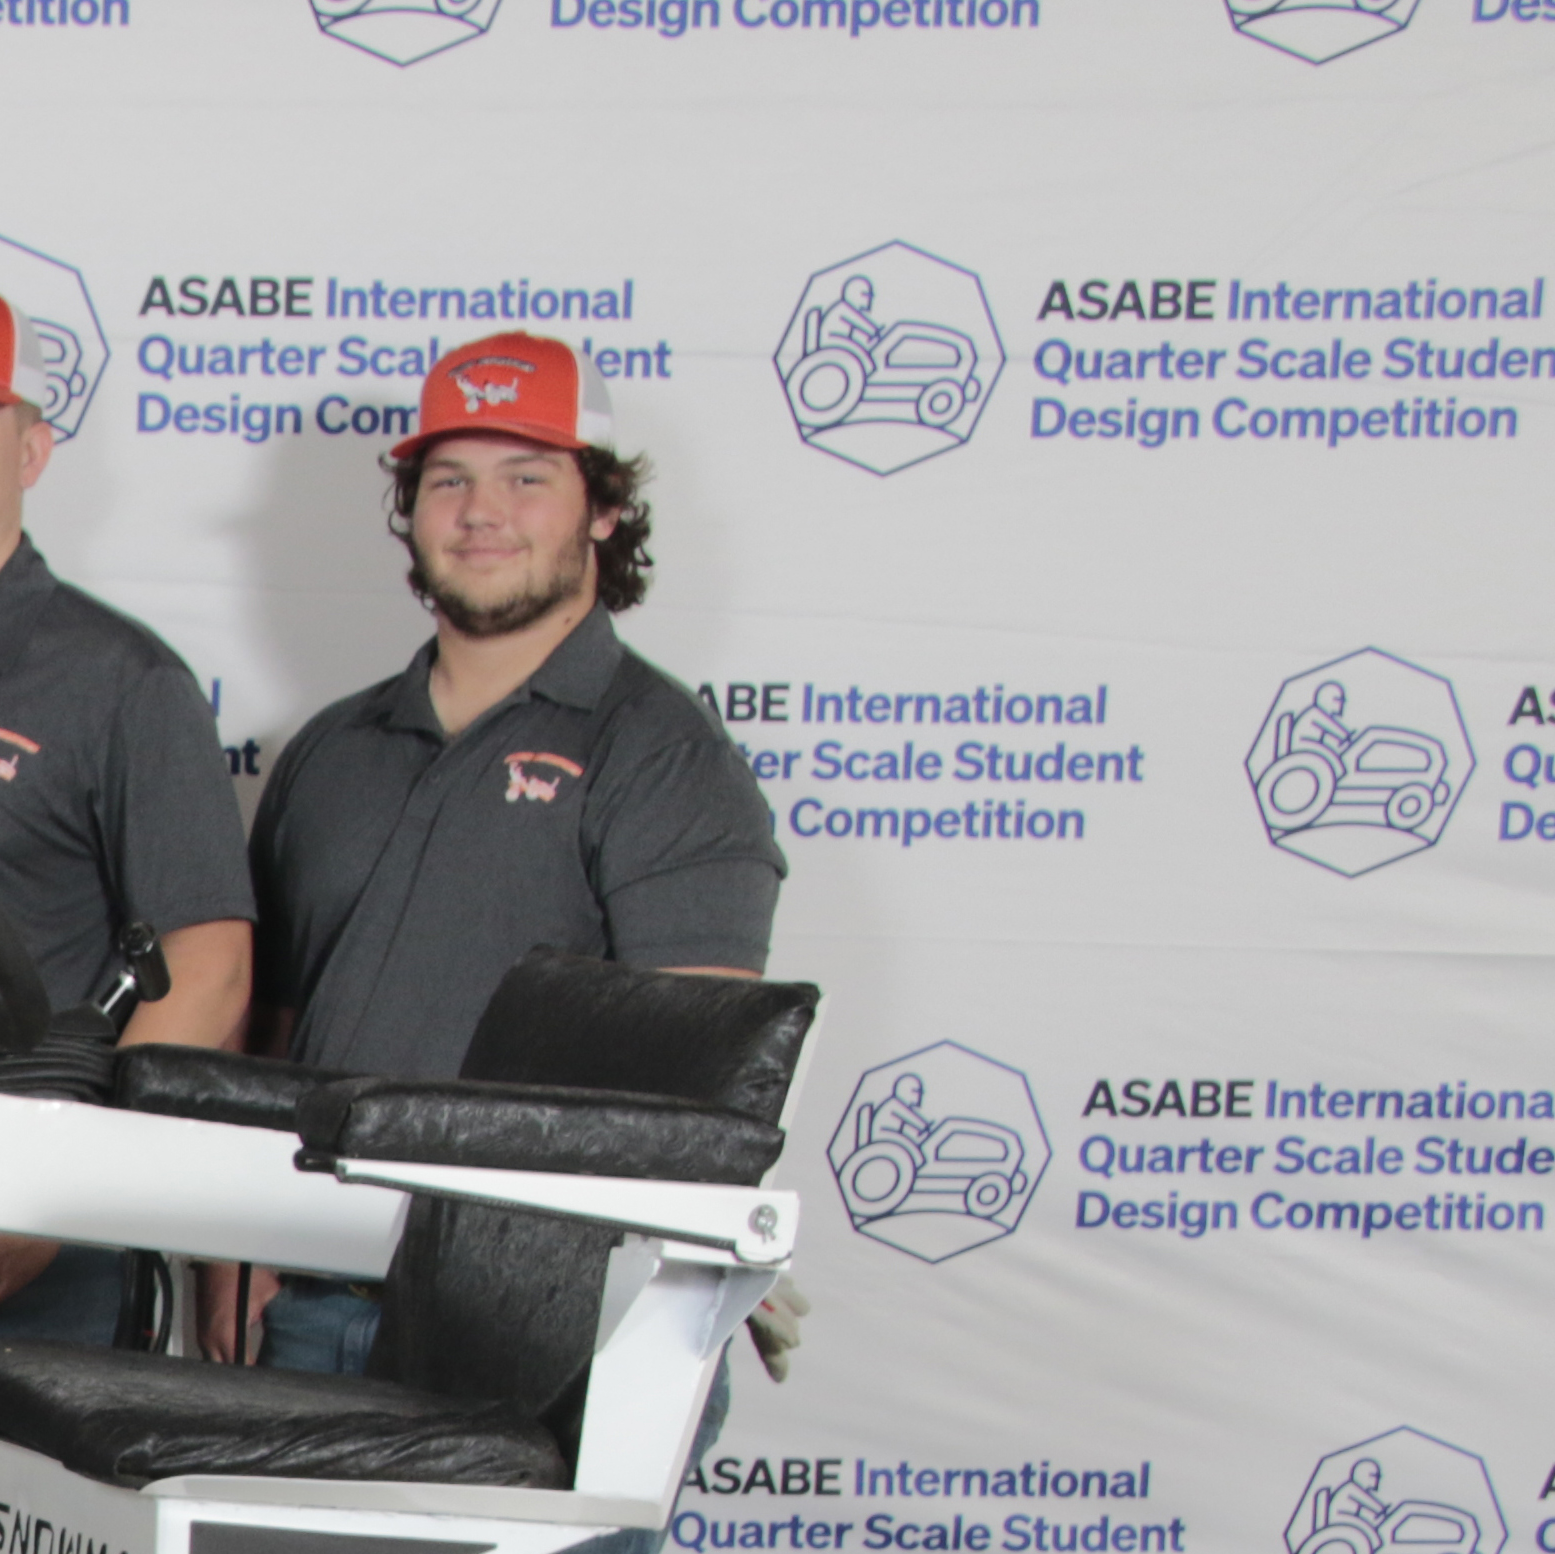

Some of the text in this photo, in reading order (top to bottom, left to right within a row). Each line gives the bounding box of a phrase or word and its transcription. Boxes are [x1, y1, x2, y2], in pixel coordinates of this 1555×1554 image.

[549, 0, 1039, 37] Design Competition
[139, 276, 633, 319] ASABE International
[1037, 278, 1544, 321] ASABE International
[138, 335, 326, 380] Quarter
[337, 338, 432, 376] Scal
[1033, 338, 1555, 385] Quarter Scale Studen
[137, 393, 302, 444] Design
[1031, 397, 1517, 448] Design Competition
[694, 684, 1107, 724] ABE International
[812, 741, 942, 781] Scale
[954, 742, 1144, 782] Student
[789, 798, 1084, 847] Competition
[1082, 1079, 1555, 1119] ASABE Internationa
[1079, 1135, 1555, 1179] Quarter Scale Stude
[1075, 1191, 1544, 1239] Design Competition
[683, 1459, 1150, 1499] ASABE International
[862, 1513, 991, 1552] Scale
[1002, 1514, 1185, 1552] Student
